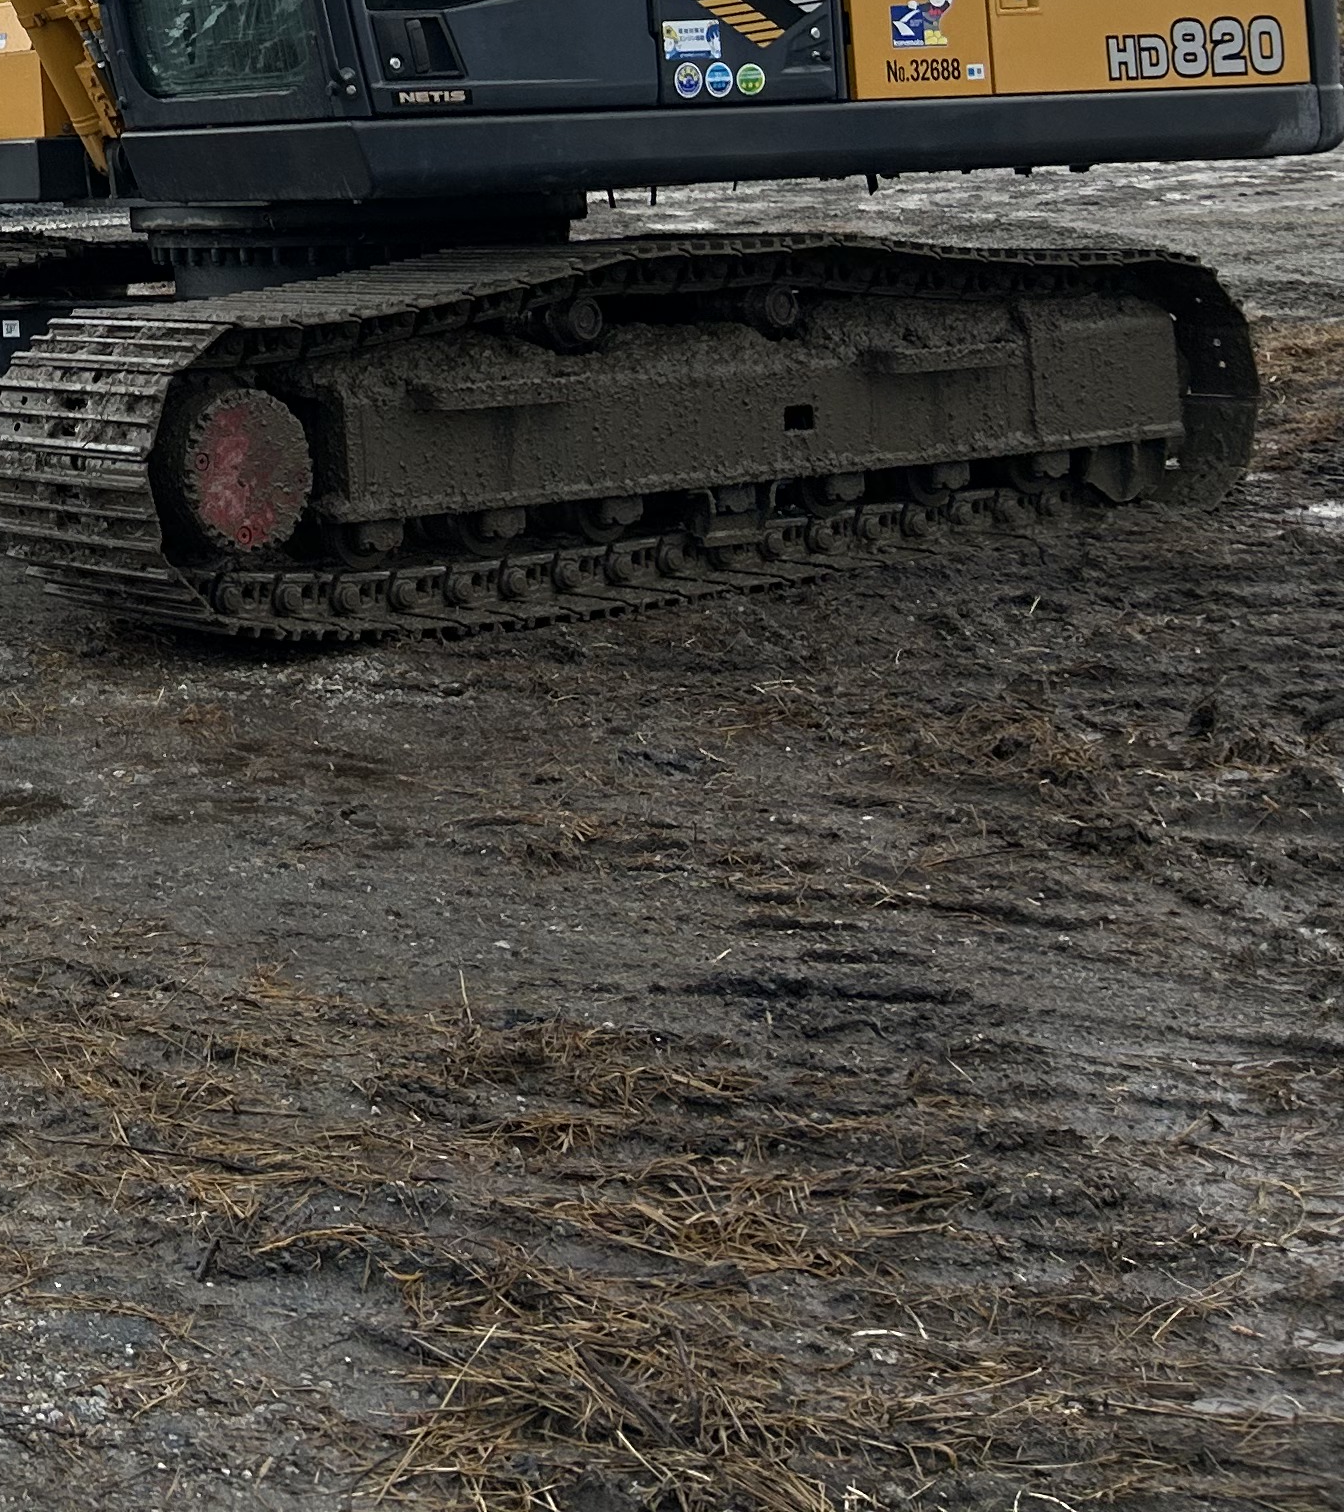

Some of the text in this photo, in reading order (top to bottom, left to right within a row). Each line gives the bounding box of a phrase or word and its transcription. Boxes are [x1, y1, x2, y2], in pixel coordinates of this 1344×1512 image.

[1105, 15, 1284, 81] HD820
[886, 58, 961, 83] No.32688
[399, 91, 466, 104] NETIS
